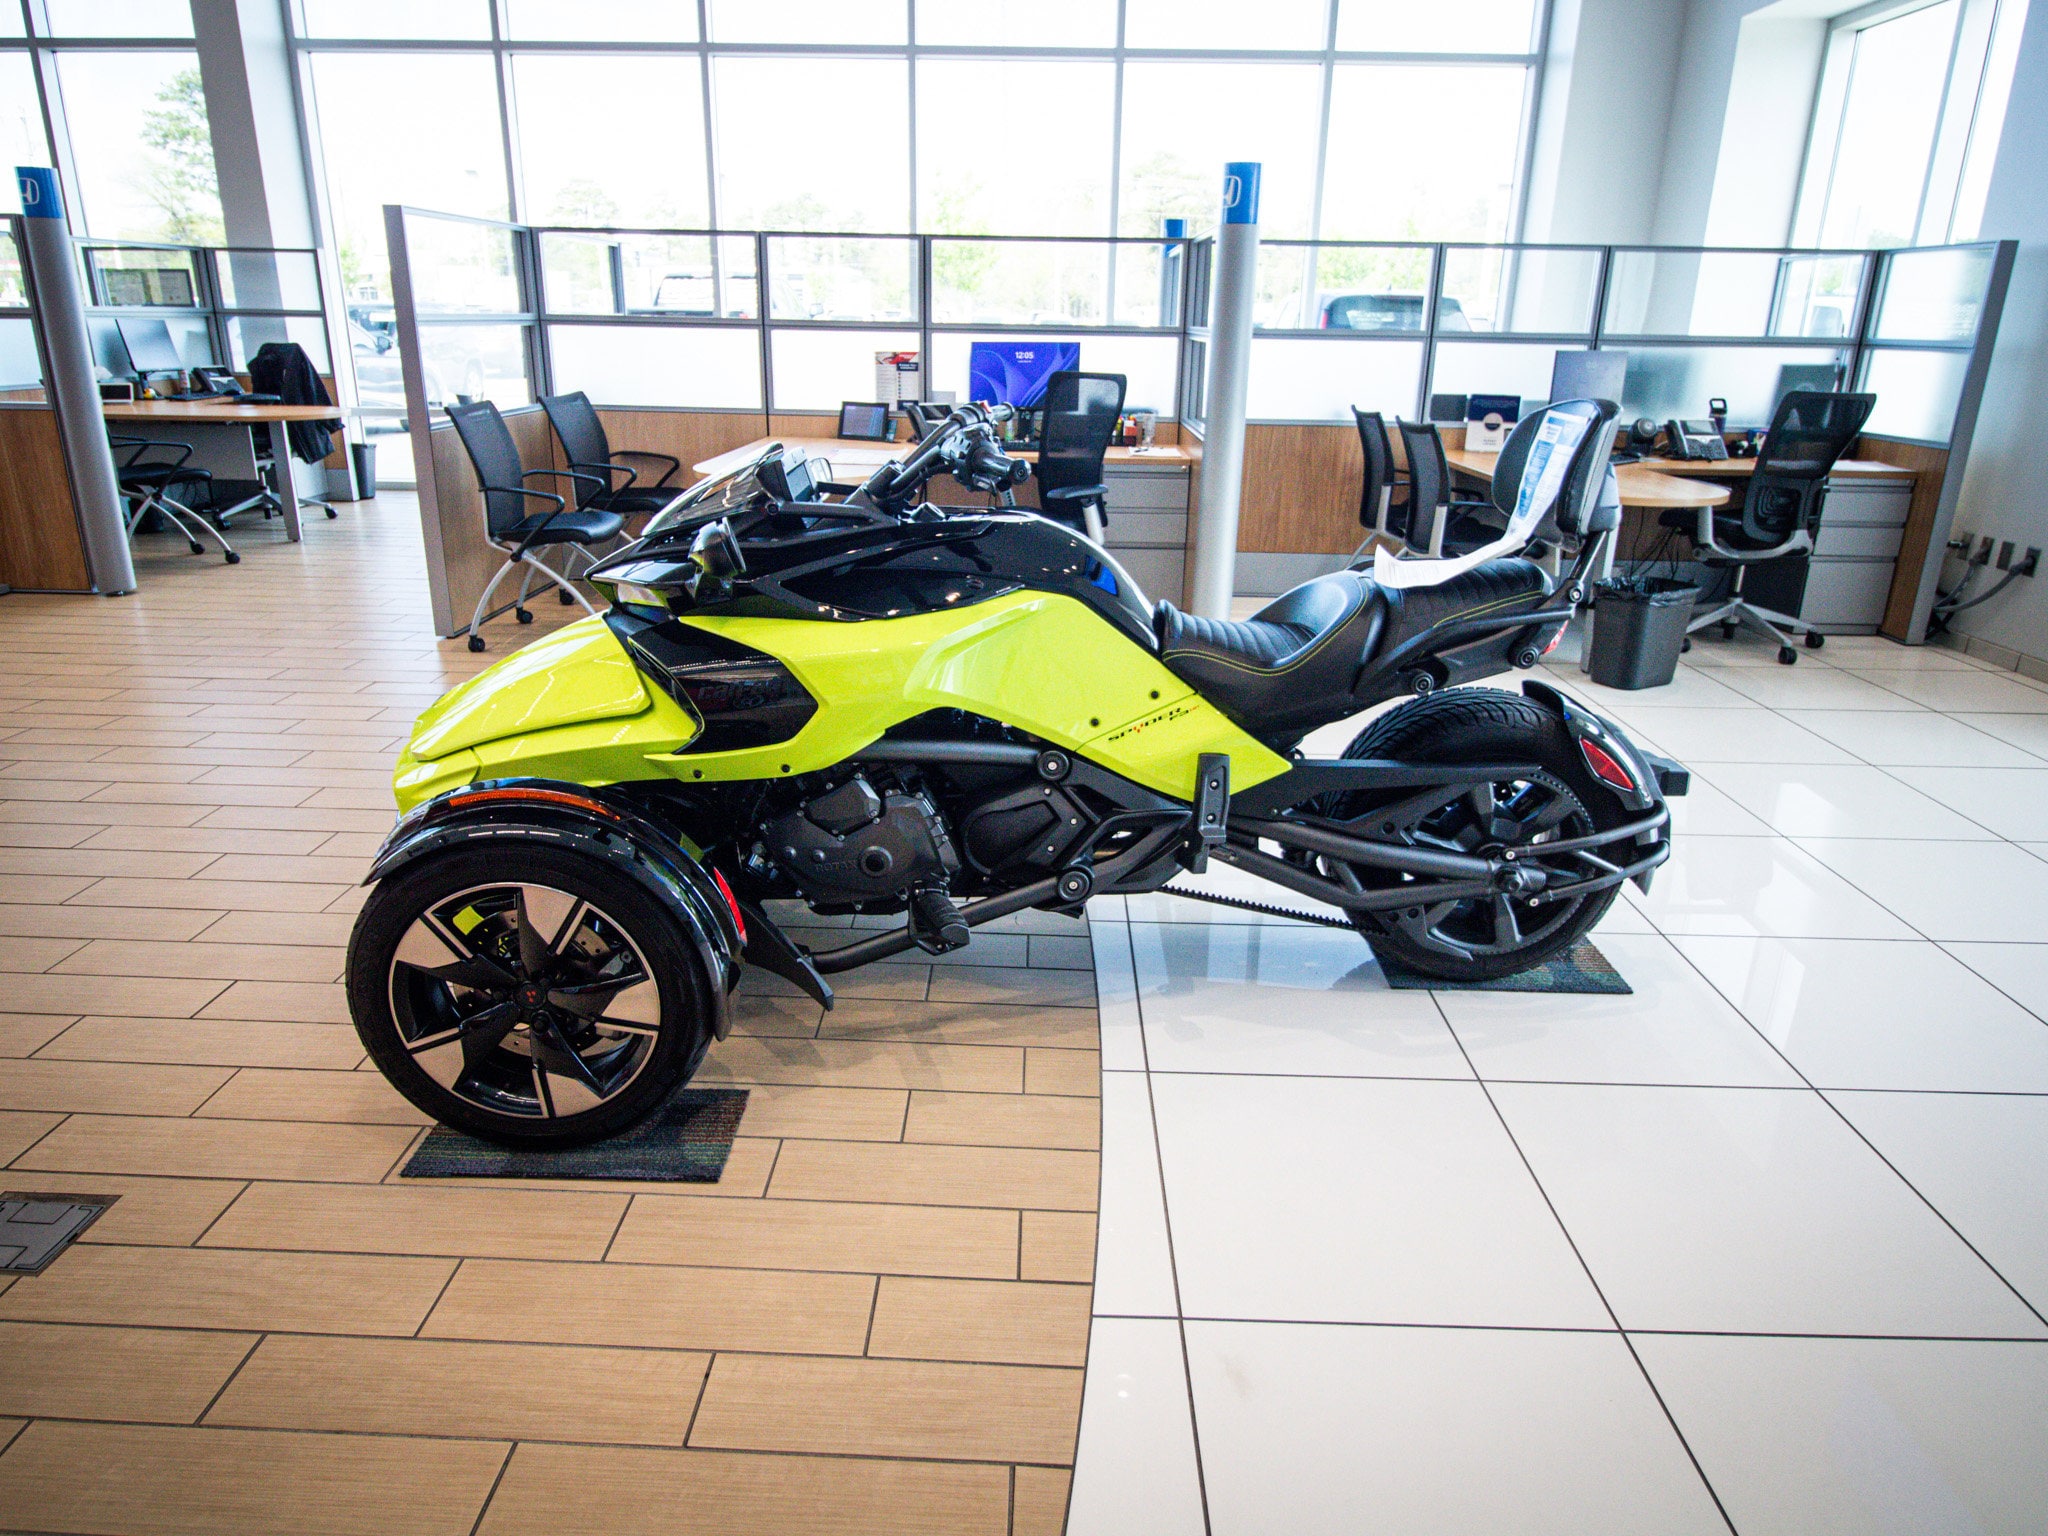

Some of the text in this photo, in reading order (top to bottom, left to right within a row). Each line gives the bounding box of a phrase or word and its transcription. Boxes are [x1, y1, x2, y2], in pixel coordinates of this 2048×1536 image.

[1015, 351, 1034, 359] 12:05
[1108, 707, 1181, 741] SPYDER
[814, 860, 858, 873] ROTAX
